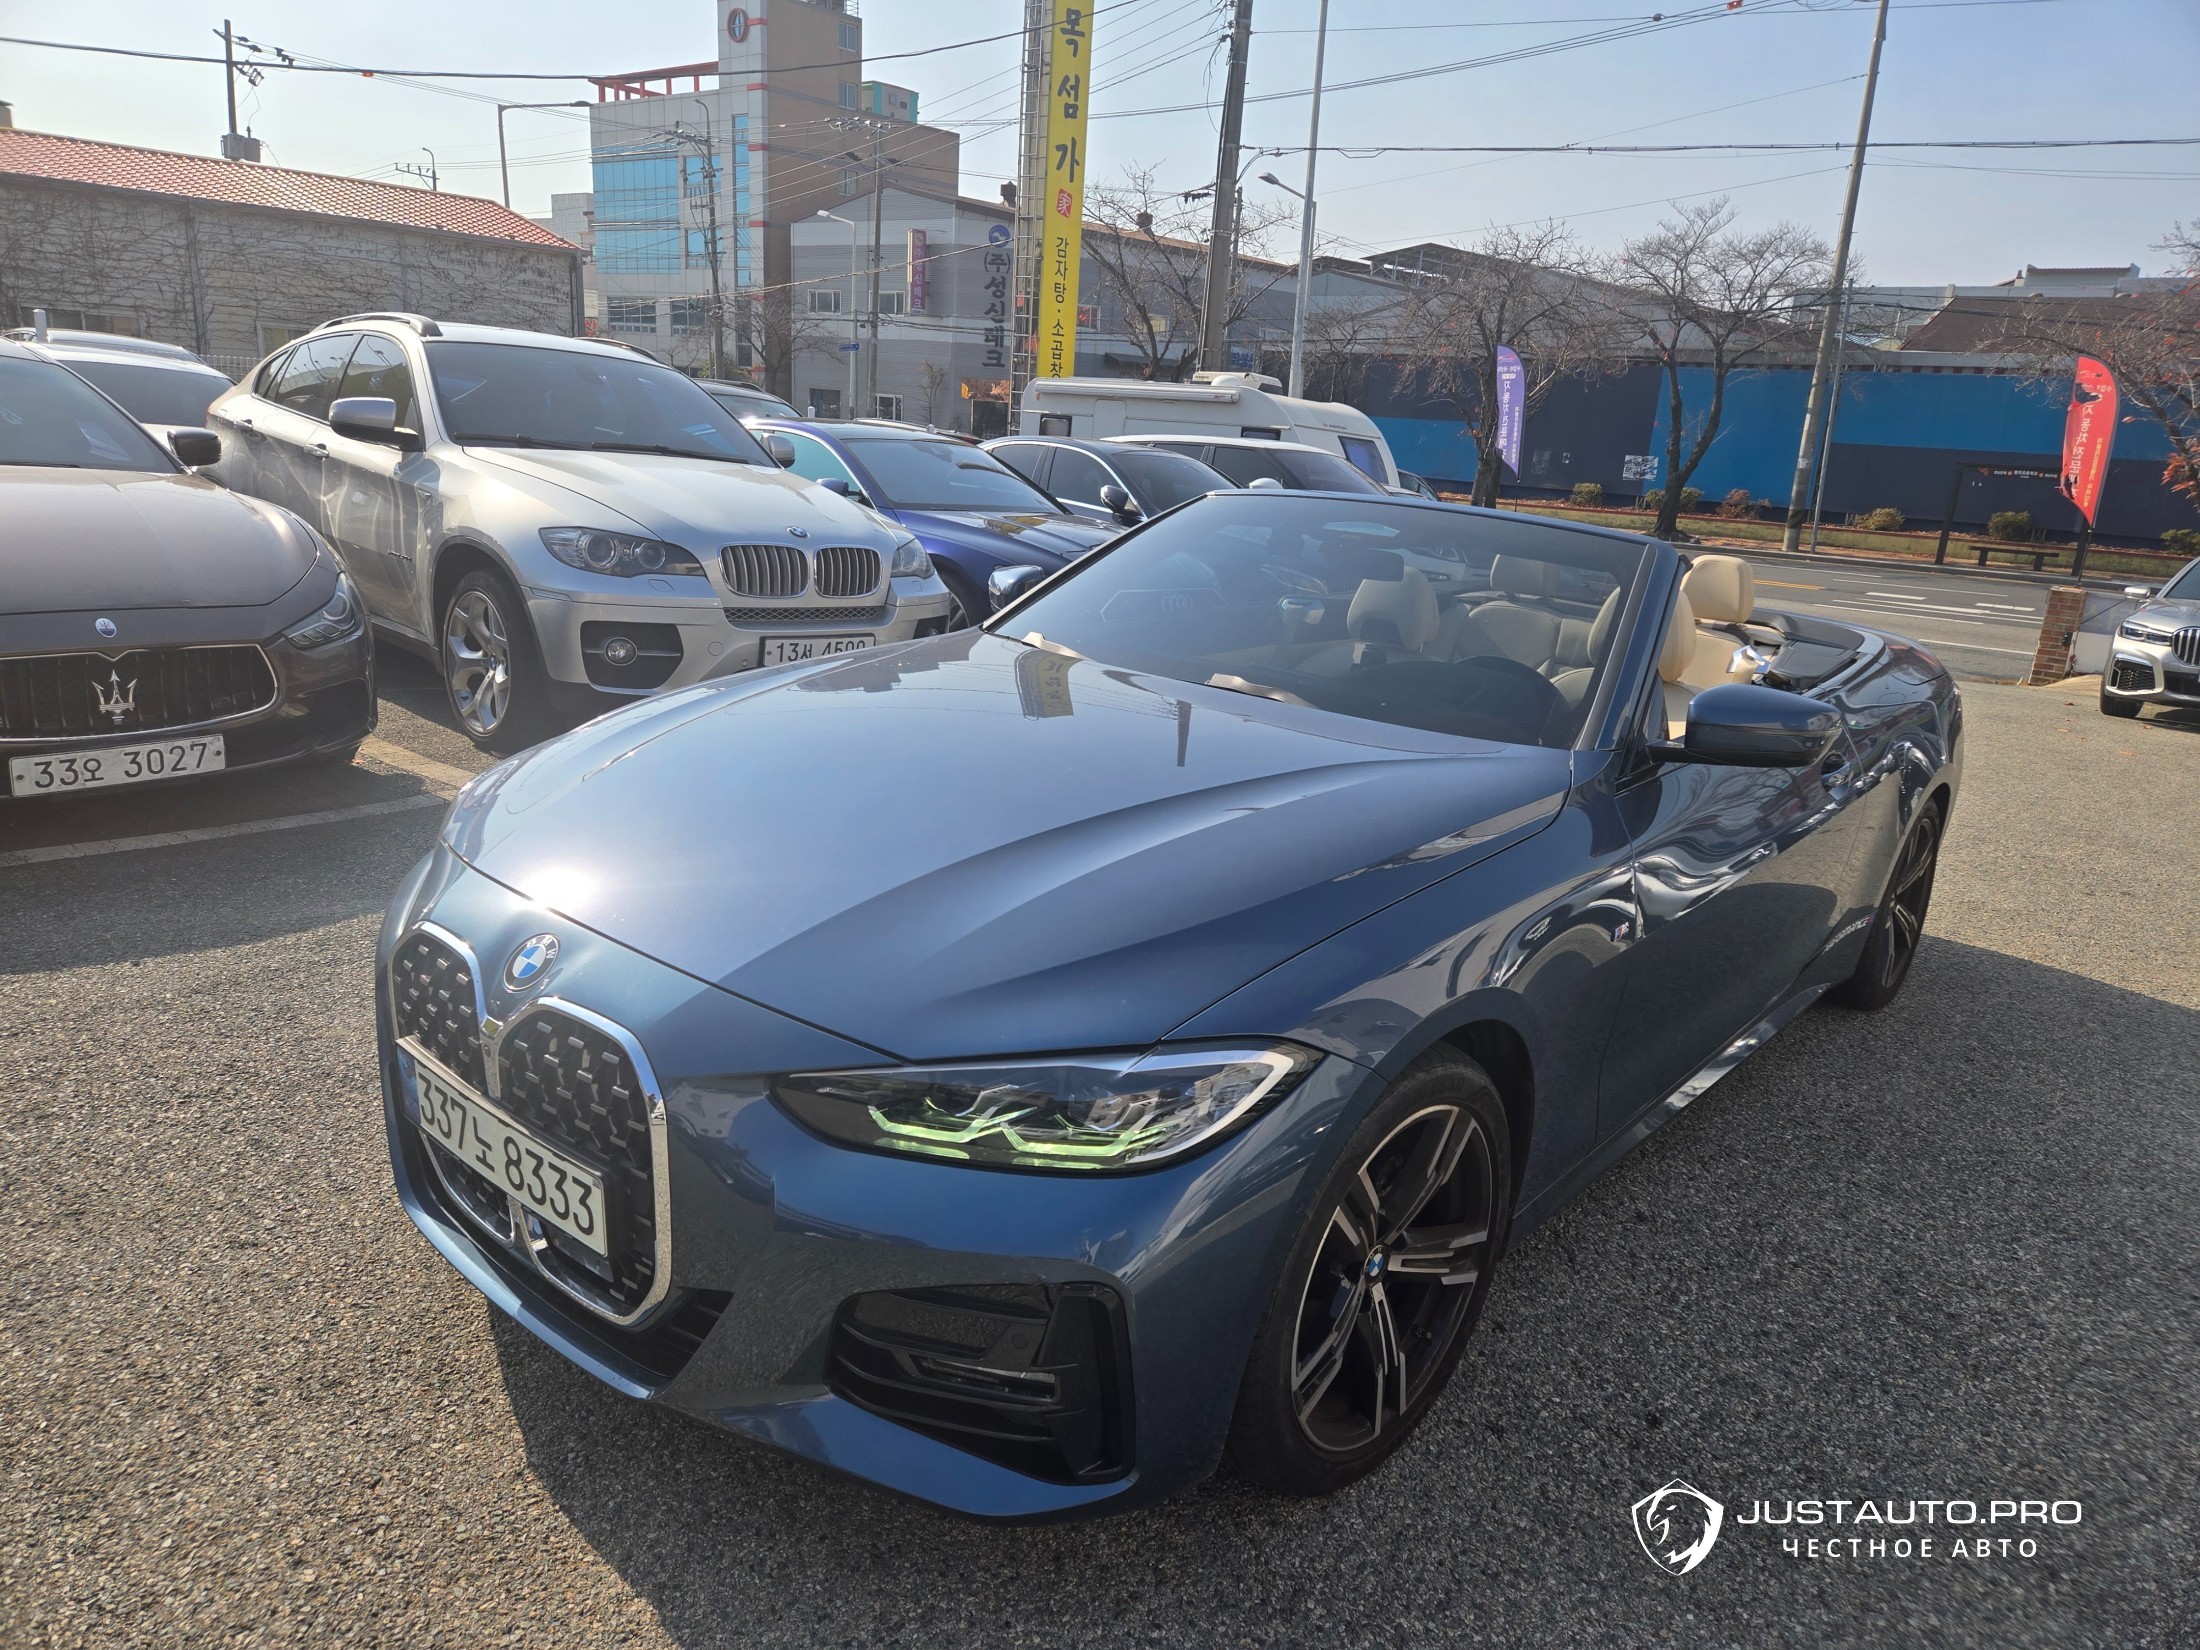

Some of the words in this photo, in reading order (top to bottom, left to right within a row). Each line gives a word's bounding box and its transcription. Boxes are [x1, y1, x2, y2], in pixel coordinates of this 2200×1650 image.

[33, 758, 104, 788] 33오
[123, 742, 208, 778] 3027
[526, 935, 557, 959] BMW
[417, 1072, 495, 1173] 337노
[503, 1135, 595, 1236] 8333
